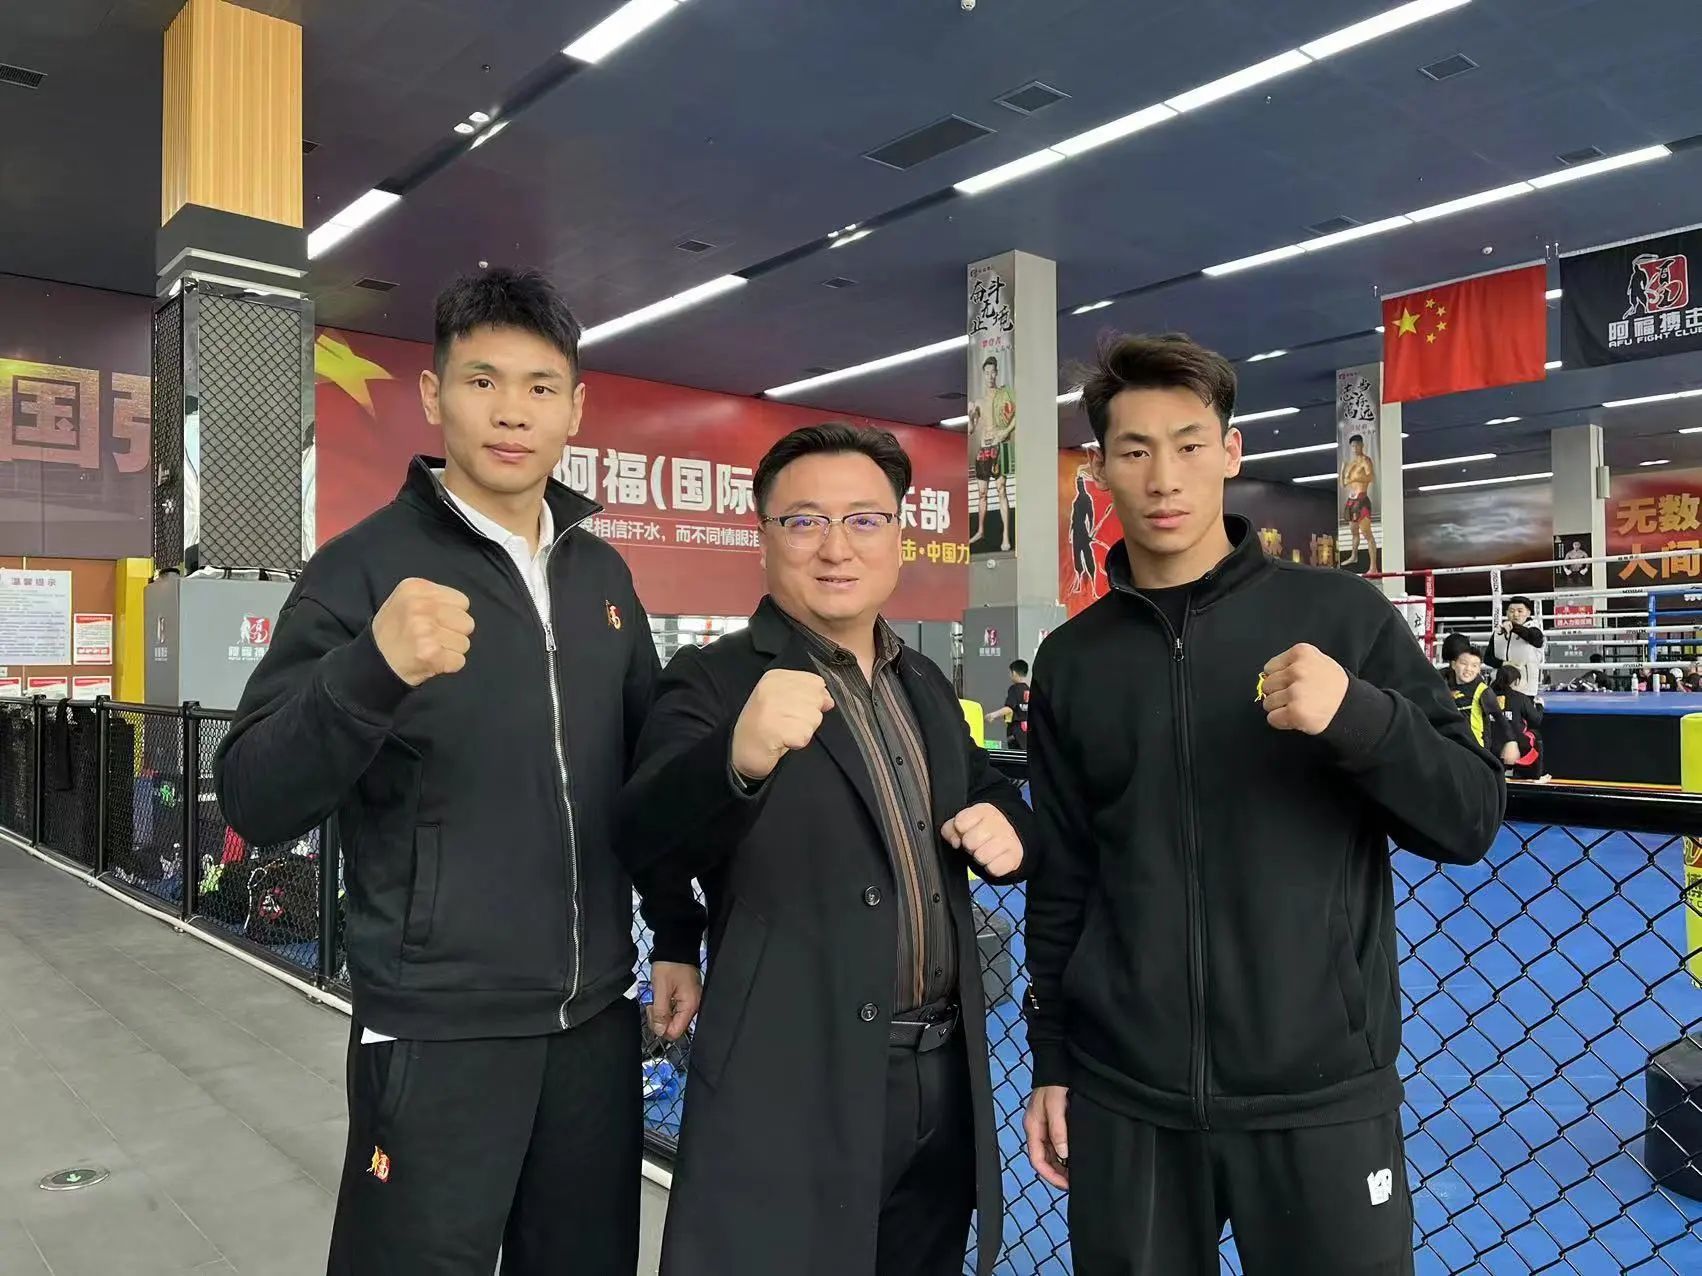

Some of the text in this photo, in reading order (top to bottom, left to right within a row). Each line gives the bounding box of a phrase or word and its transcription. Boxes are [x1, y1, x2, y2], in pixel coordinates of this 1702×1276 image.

[1609, 308, 1702, 341] 阿福搏击
[1609, 339, 1632, 348] AFU
[1637, 333, 1670, 344] FIGHT
[1616, 493, 1701, 535] 无数
[1618, 540, 1701, 580] 人间
